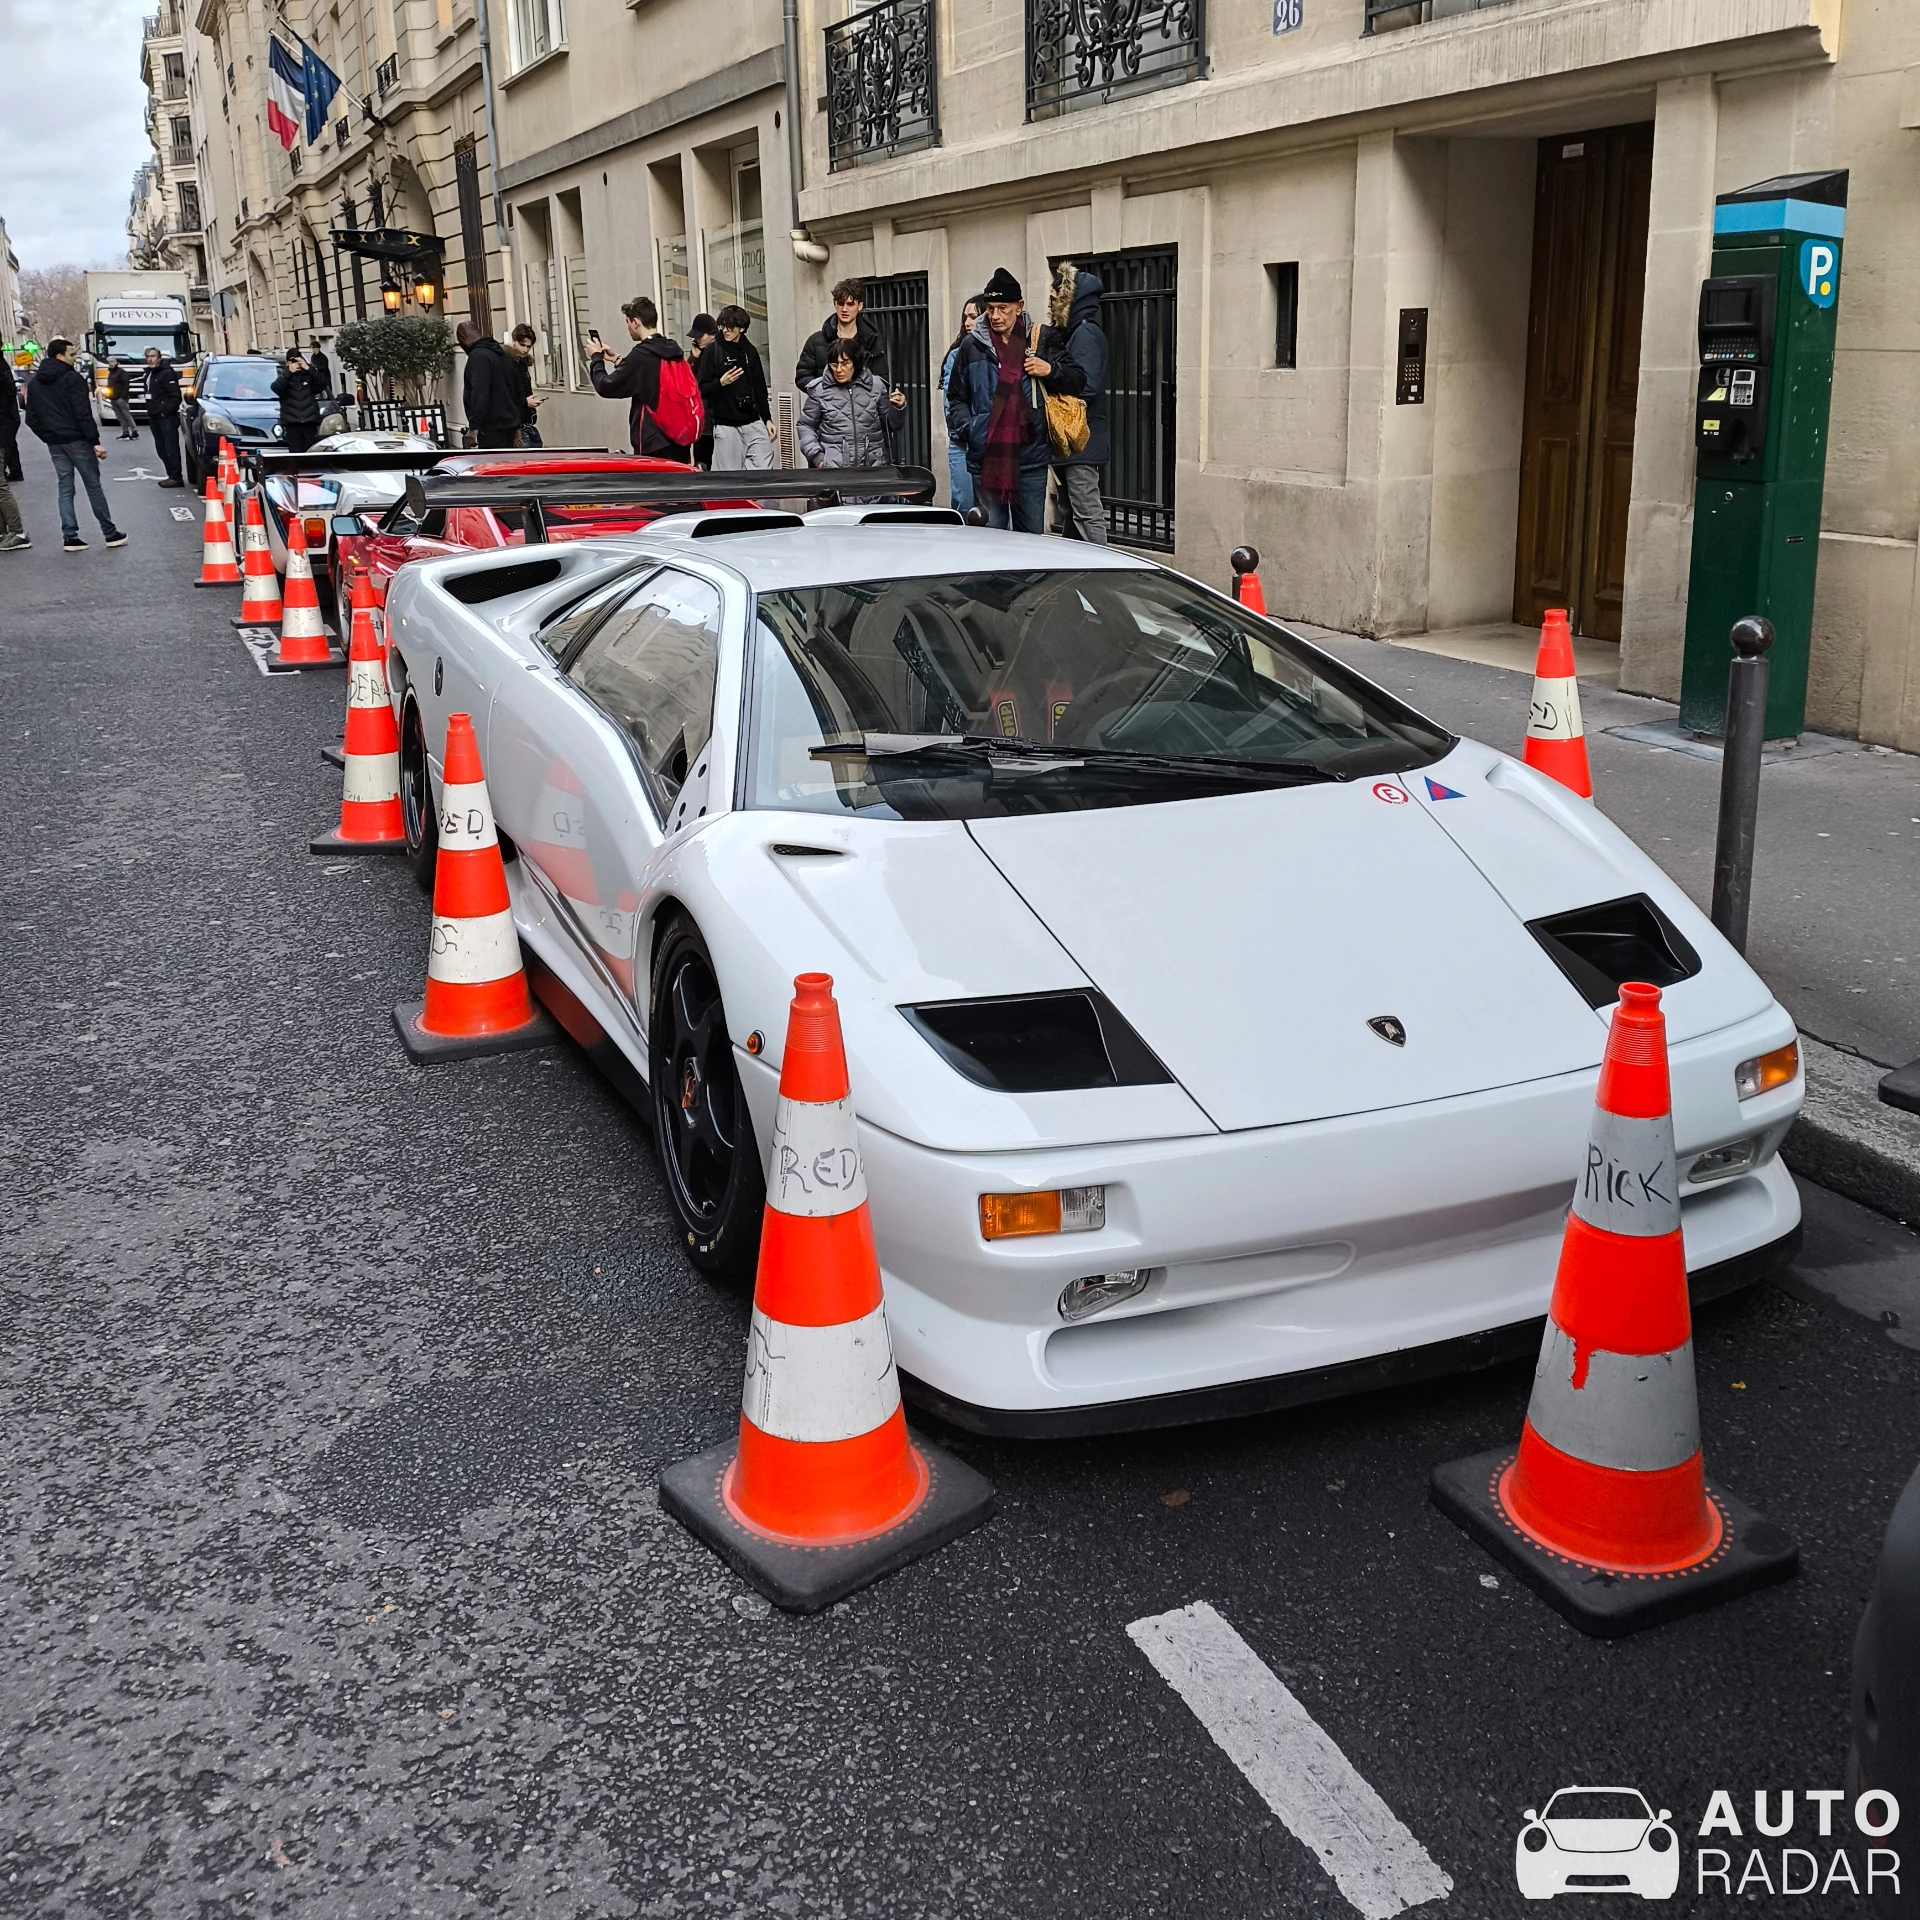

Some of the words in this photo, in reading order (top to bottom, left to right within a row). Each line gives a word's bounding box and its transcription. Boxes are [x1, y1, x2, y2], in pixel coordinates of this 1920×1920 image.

[1276, 0, 1300, 31] 26
[110, 310, 171, 319] PREVOST
[775, 1143, 864, 1194] RED
